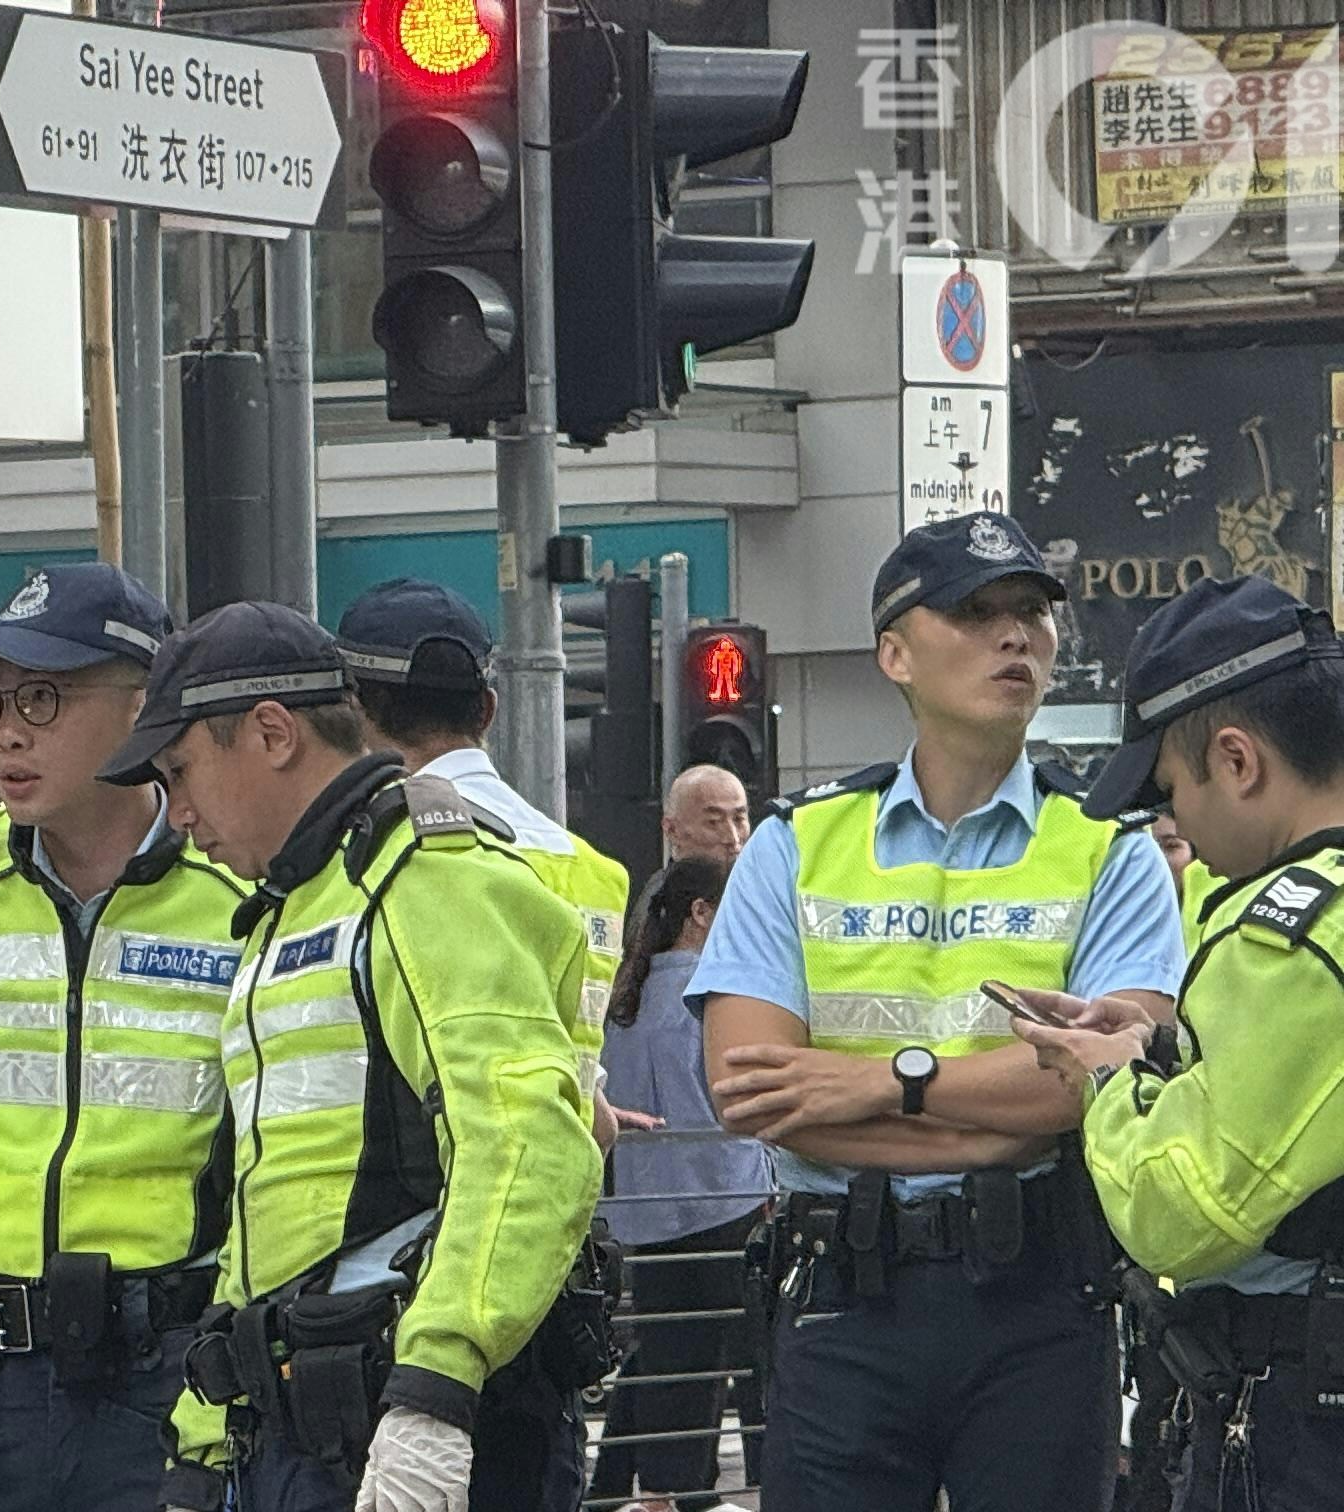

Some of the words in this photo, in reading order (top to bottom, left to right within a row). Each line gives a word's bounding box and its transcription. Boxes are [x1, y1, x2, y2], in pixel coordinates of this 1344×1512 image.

[80, 43, 119, 88] Sai
[130, 50, 174, 97] Yee
[185, 58, 264, 110] Street
[1102, 82, 1197, 115] 趙先生
[1102, 112, 1199, 148] 李先生
[121, 124, 225, 190] 洗衣街
[923, 419, 960, 450] 上午
[931, 396, 952, 412] am
[981, 399, 992, 450] 7
[911, 479, 974, 503] midnight
[1080, 555, 1212, 600] POLO
[416, 810, 467, 826] 18034
[884, 904, 988, 943] POLICE
[1006, 905, 1036, 933] 察
[1250, 903, 1299, 928] 12923
[149, 950, 212, 978] POLICE
